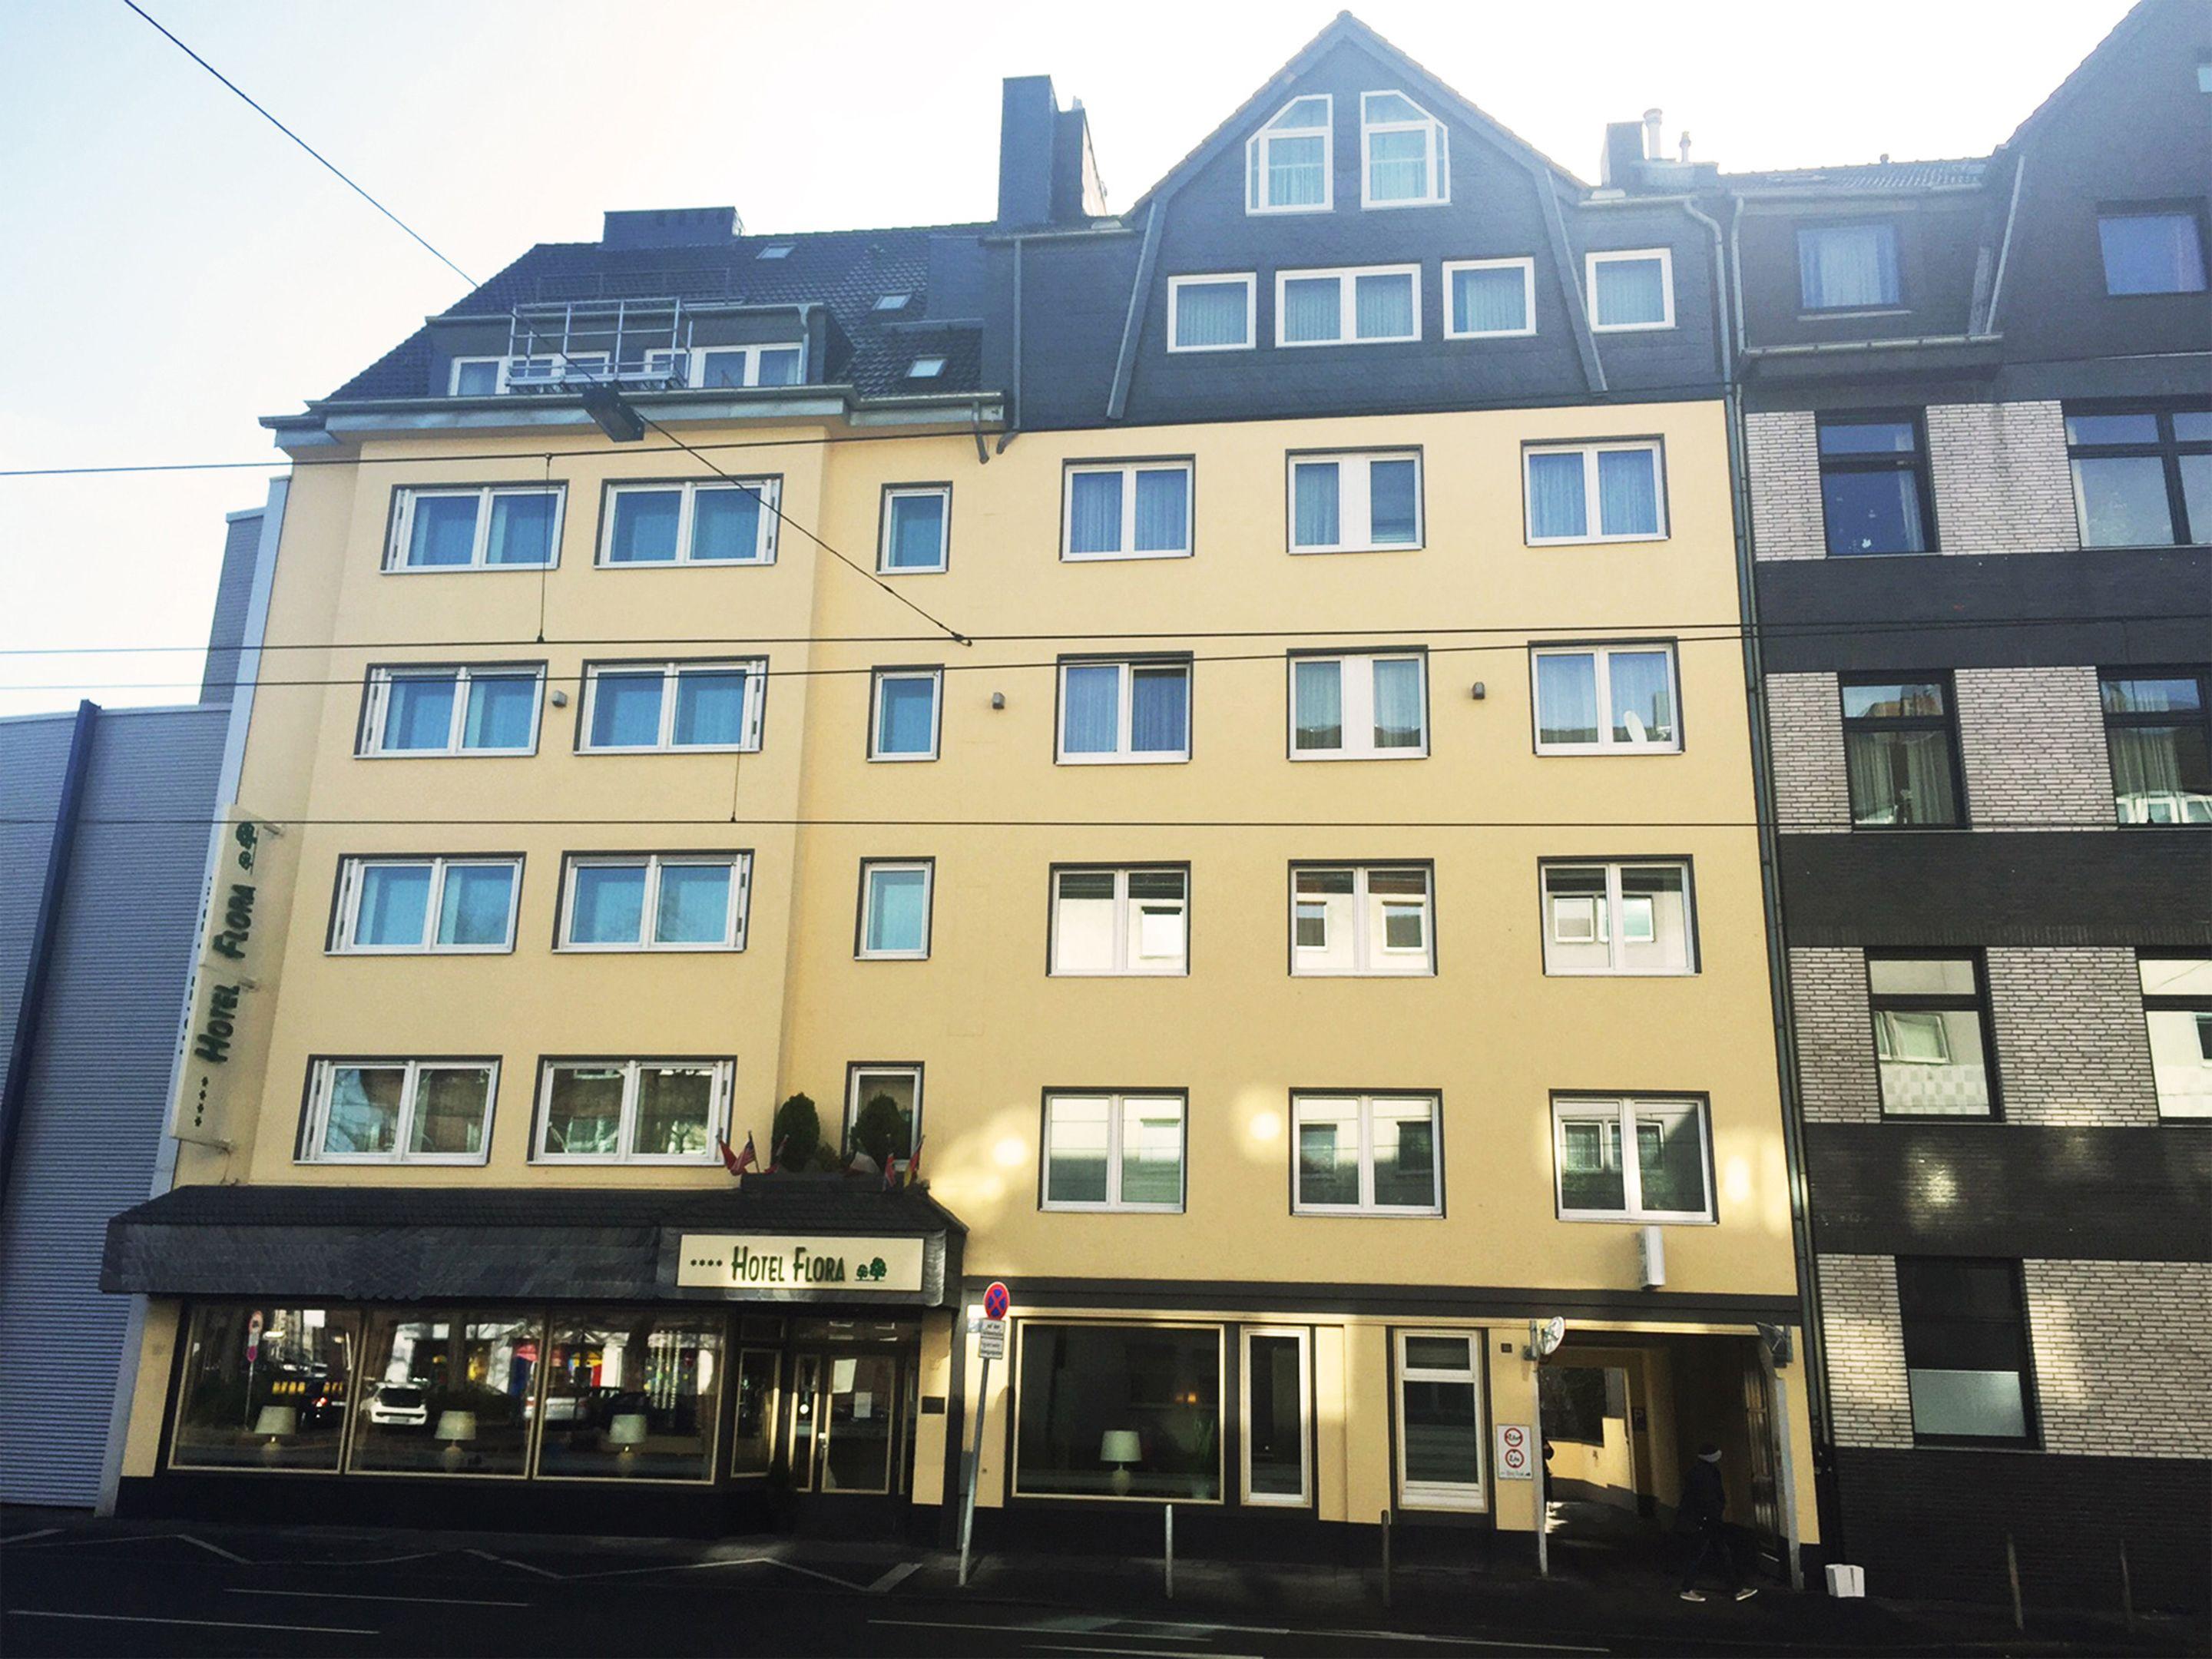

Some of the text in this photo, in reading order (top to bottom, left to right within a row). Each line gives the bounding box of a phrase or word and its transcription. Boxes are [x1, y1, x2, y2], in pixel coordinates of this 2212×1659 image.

[194, 884, 257, 1063] HOTEL FLORA
[731, 1246, 846, 1283] HOTEL FLORA
